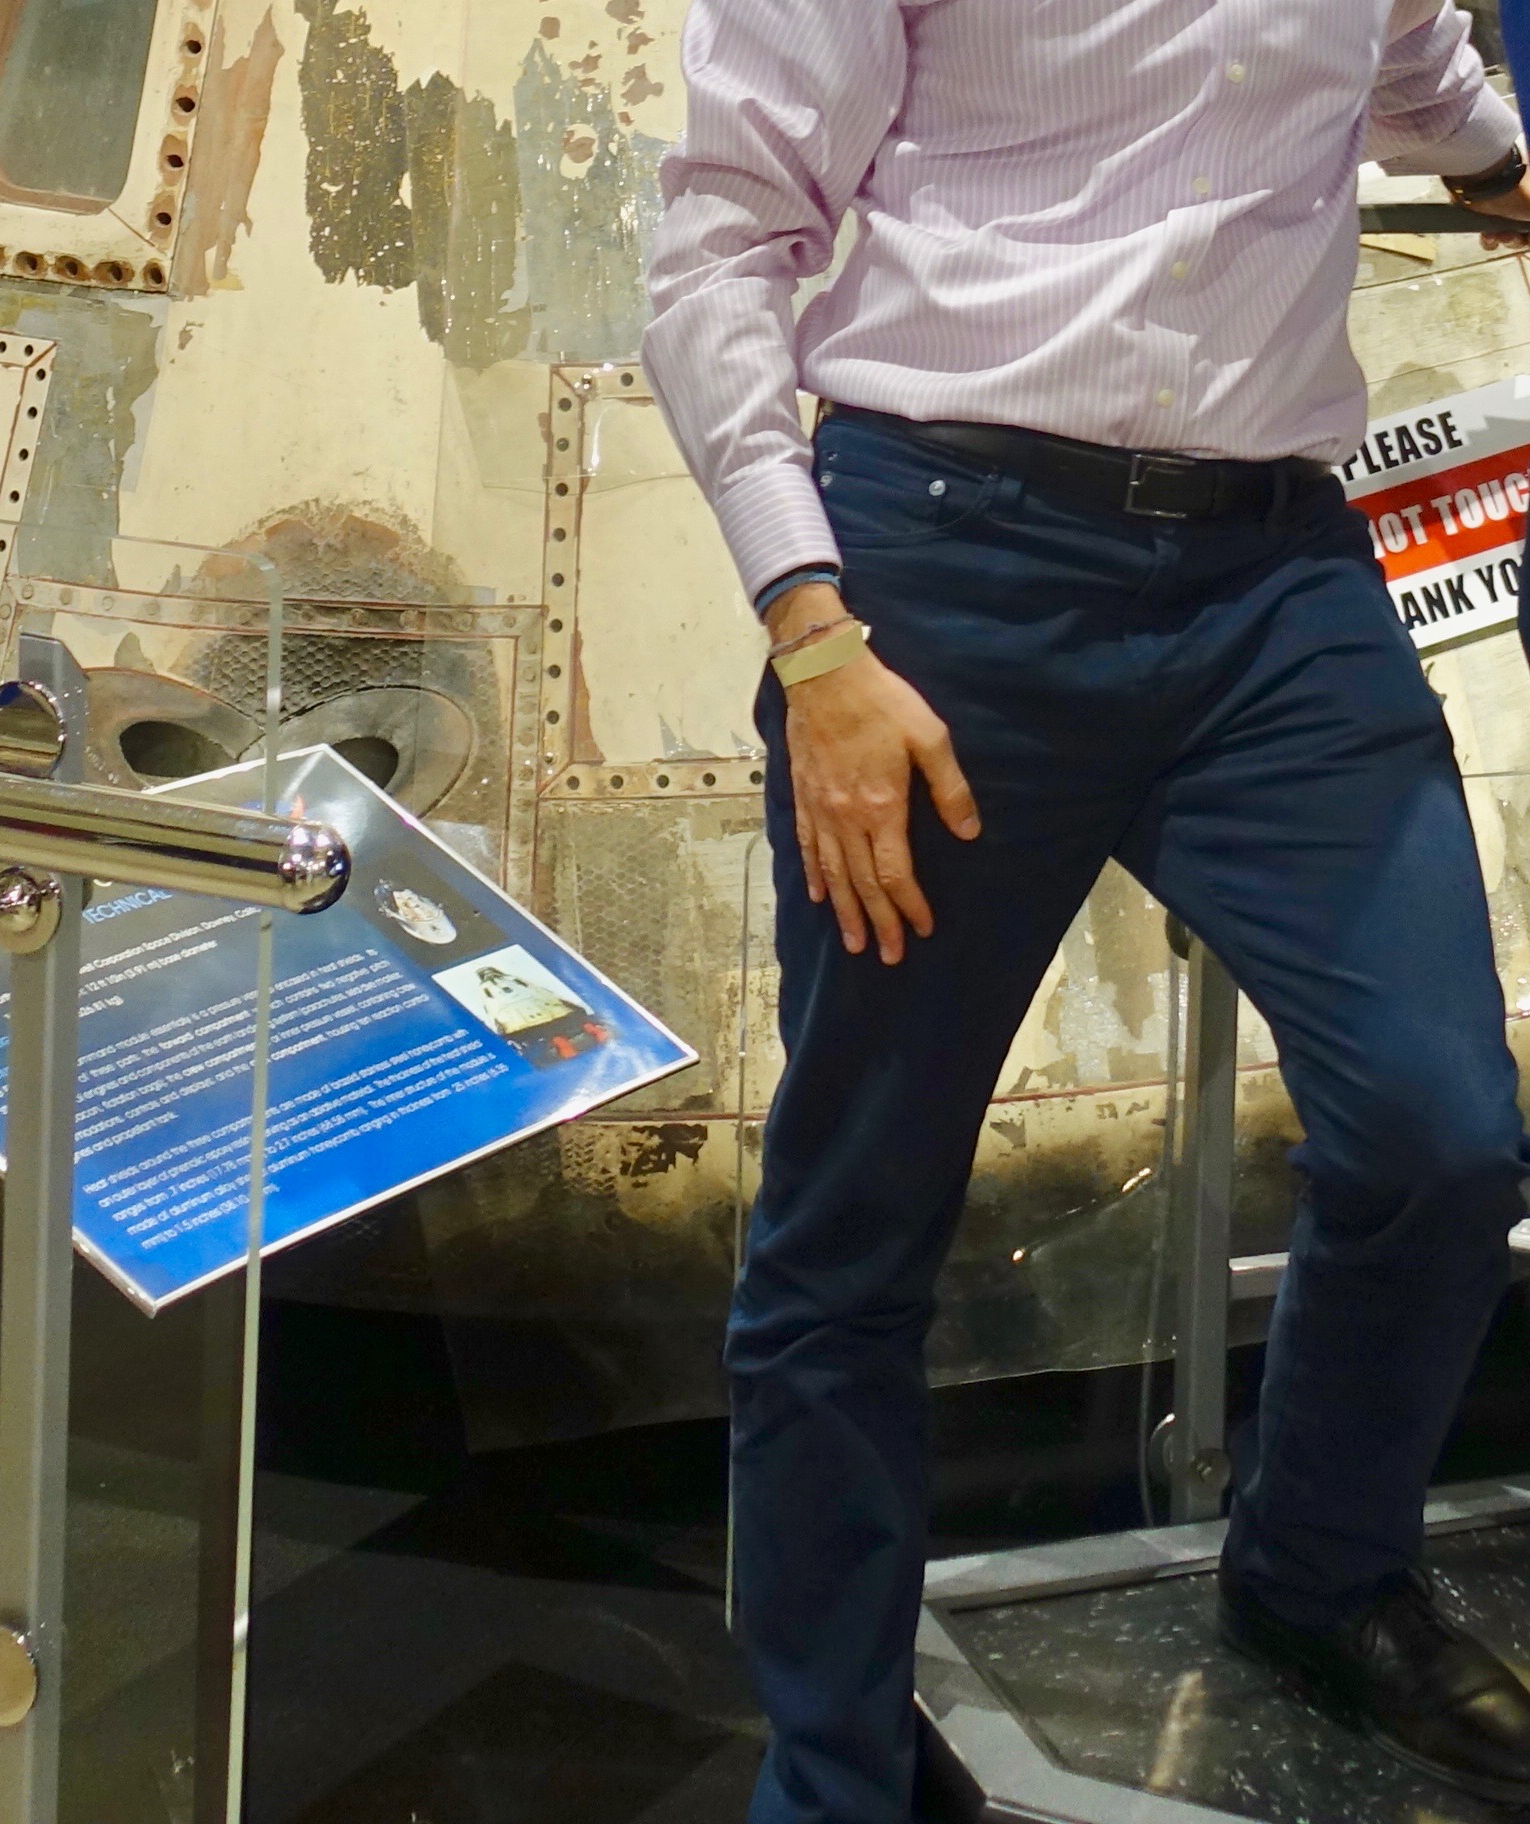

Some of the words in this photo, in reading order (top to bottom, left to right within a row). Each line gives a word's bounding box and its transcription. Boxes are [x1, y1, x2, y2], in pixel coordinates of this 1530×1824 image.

[1341, 411, 1463, 481] PLEASE
[1474, 558, 1522, 604] YO
[93, 947, 144, 967] Corporation
[142, 937, 171, 950] Space
